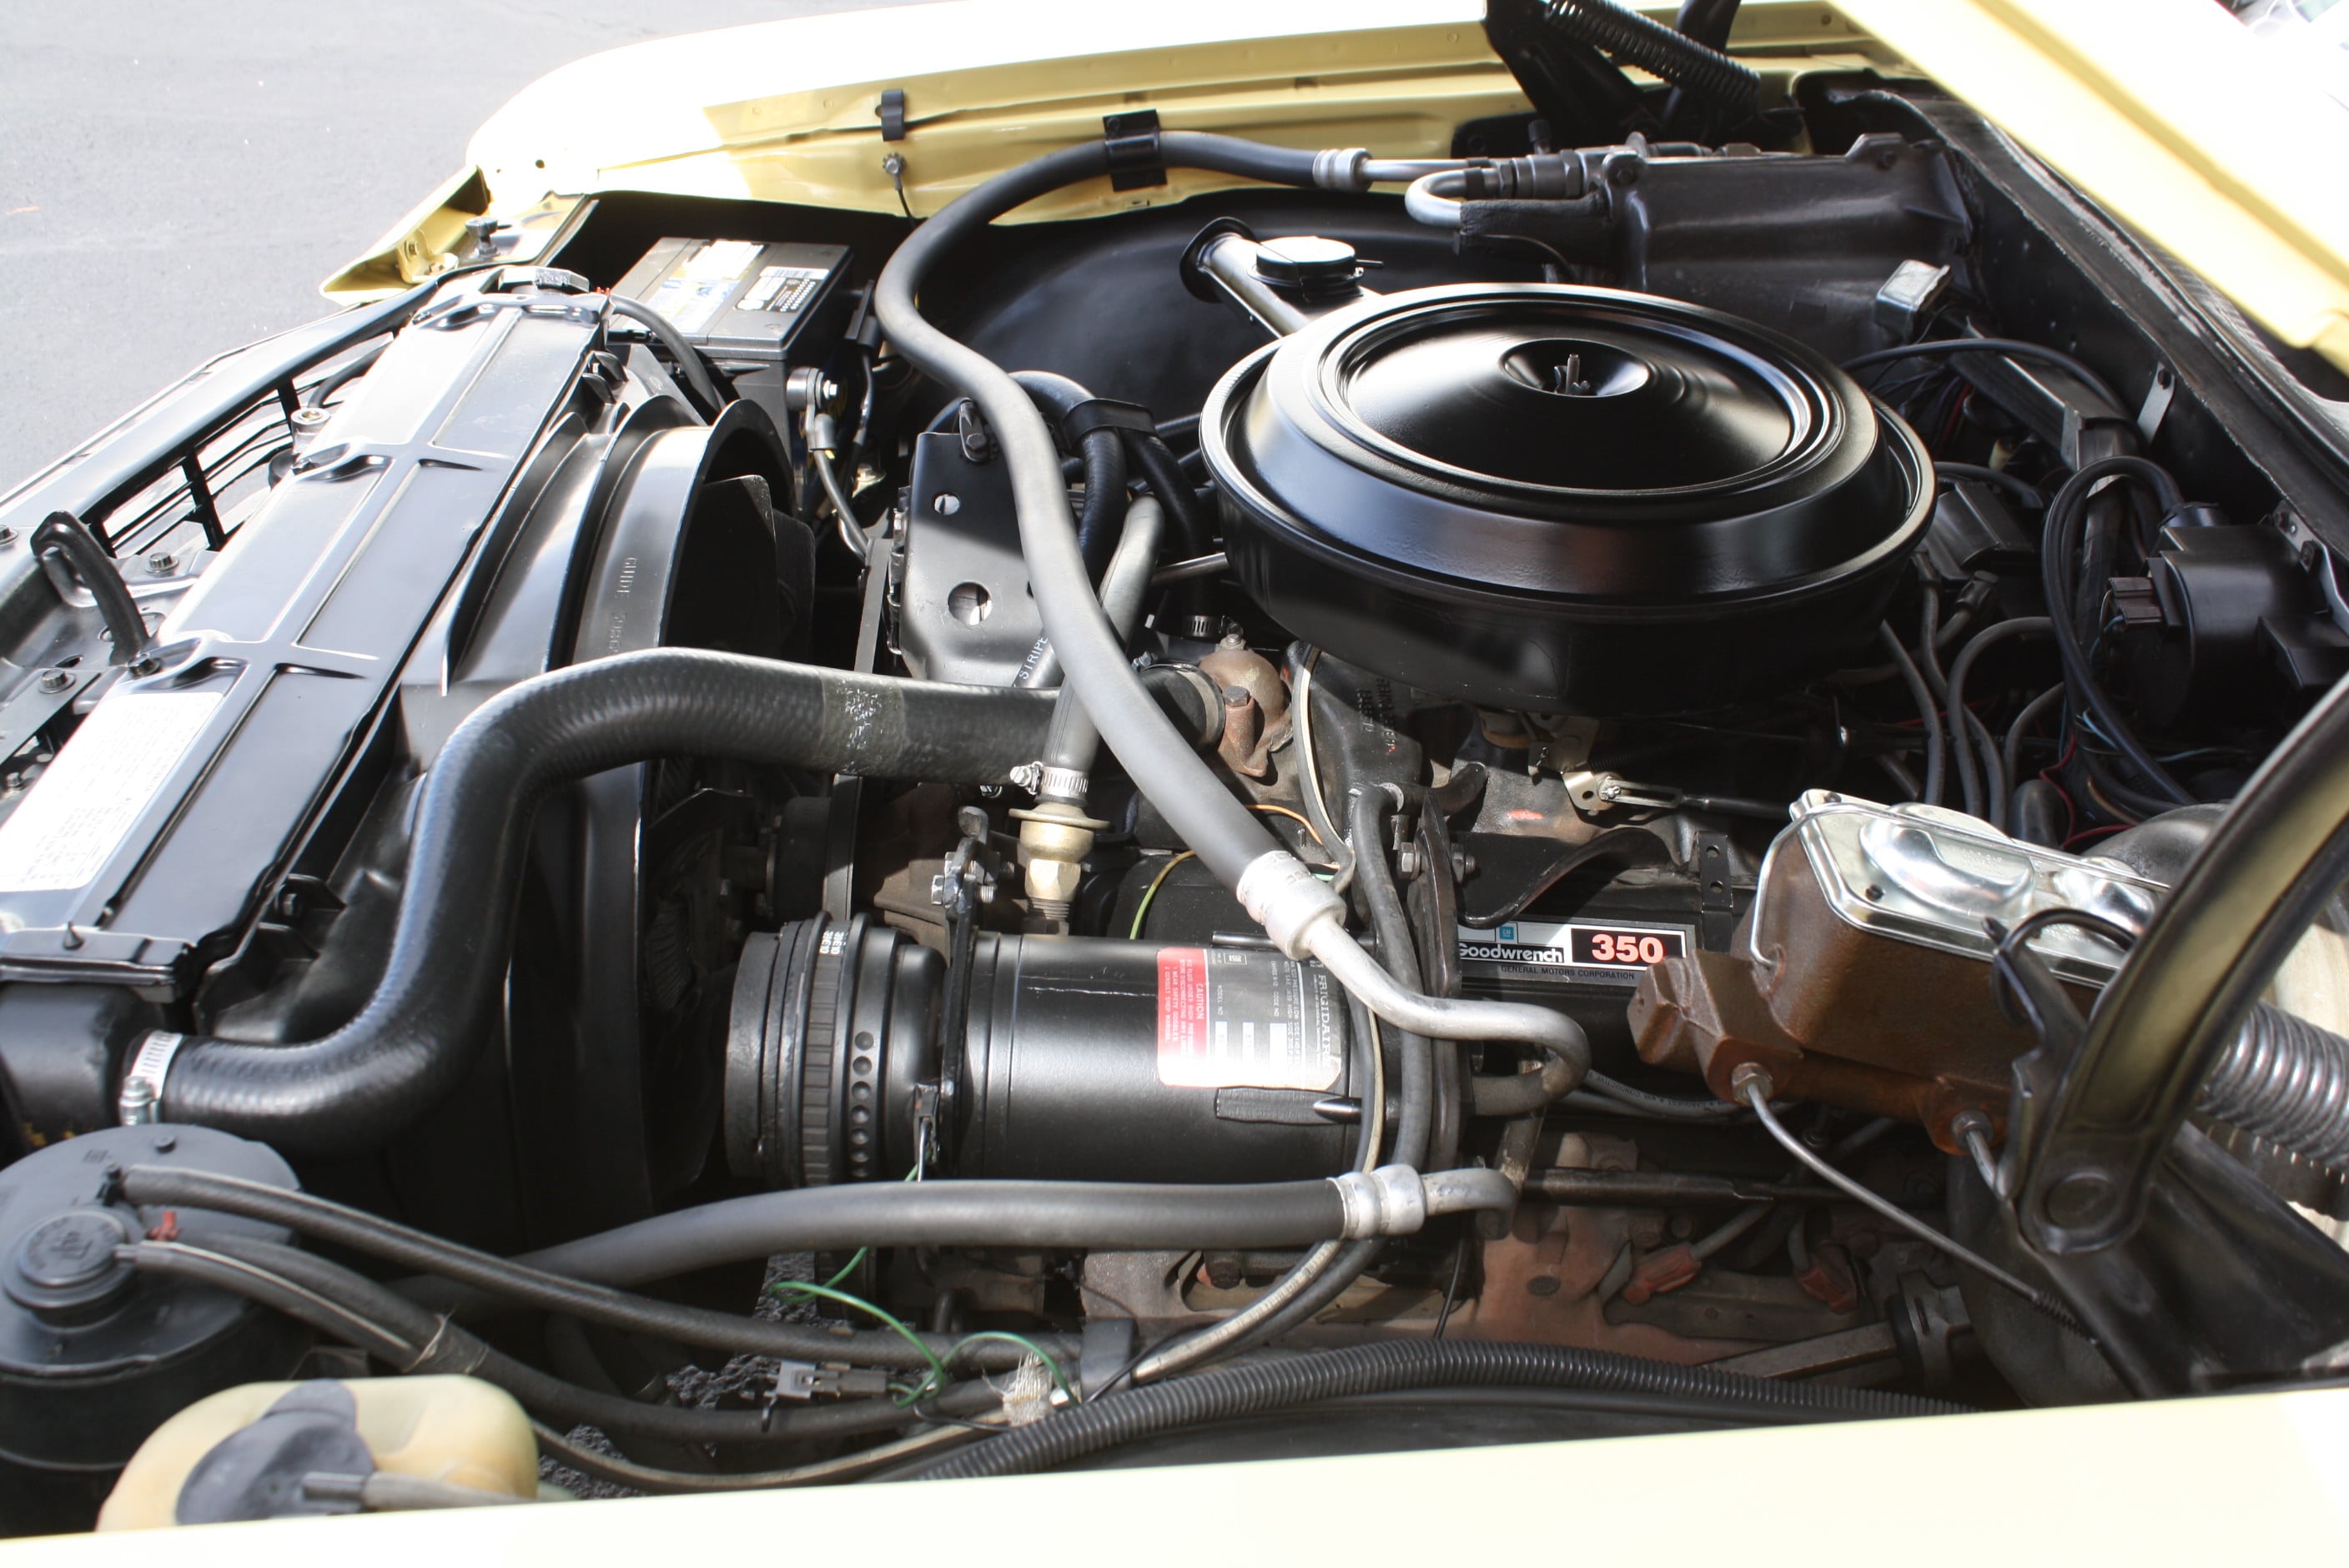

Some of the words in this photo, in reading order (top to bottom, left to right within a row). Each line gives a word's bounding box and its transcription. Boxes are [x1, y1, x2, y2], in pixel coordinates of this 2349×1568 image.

[1019, 636, 1049, 680] STRIPE
[1459, 942, 1563, 962] Goodwrench
[1591, 933, 1663, 964] 350
[1501, 965, 1539, 974] GENERAL
[1542, 967, 1576, 977] MOTORS
[1578, 969, 1635, 980] CORPORATION
[1195, 983, 1205, 1020] CAUTION
